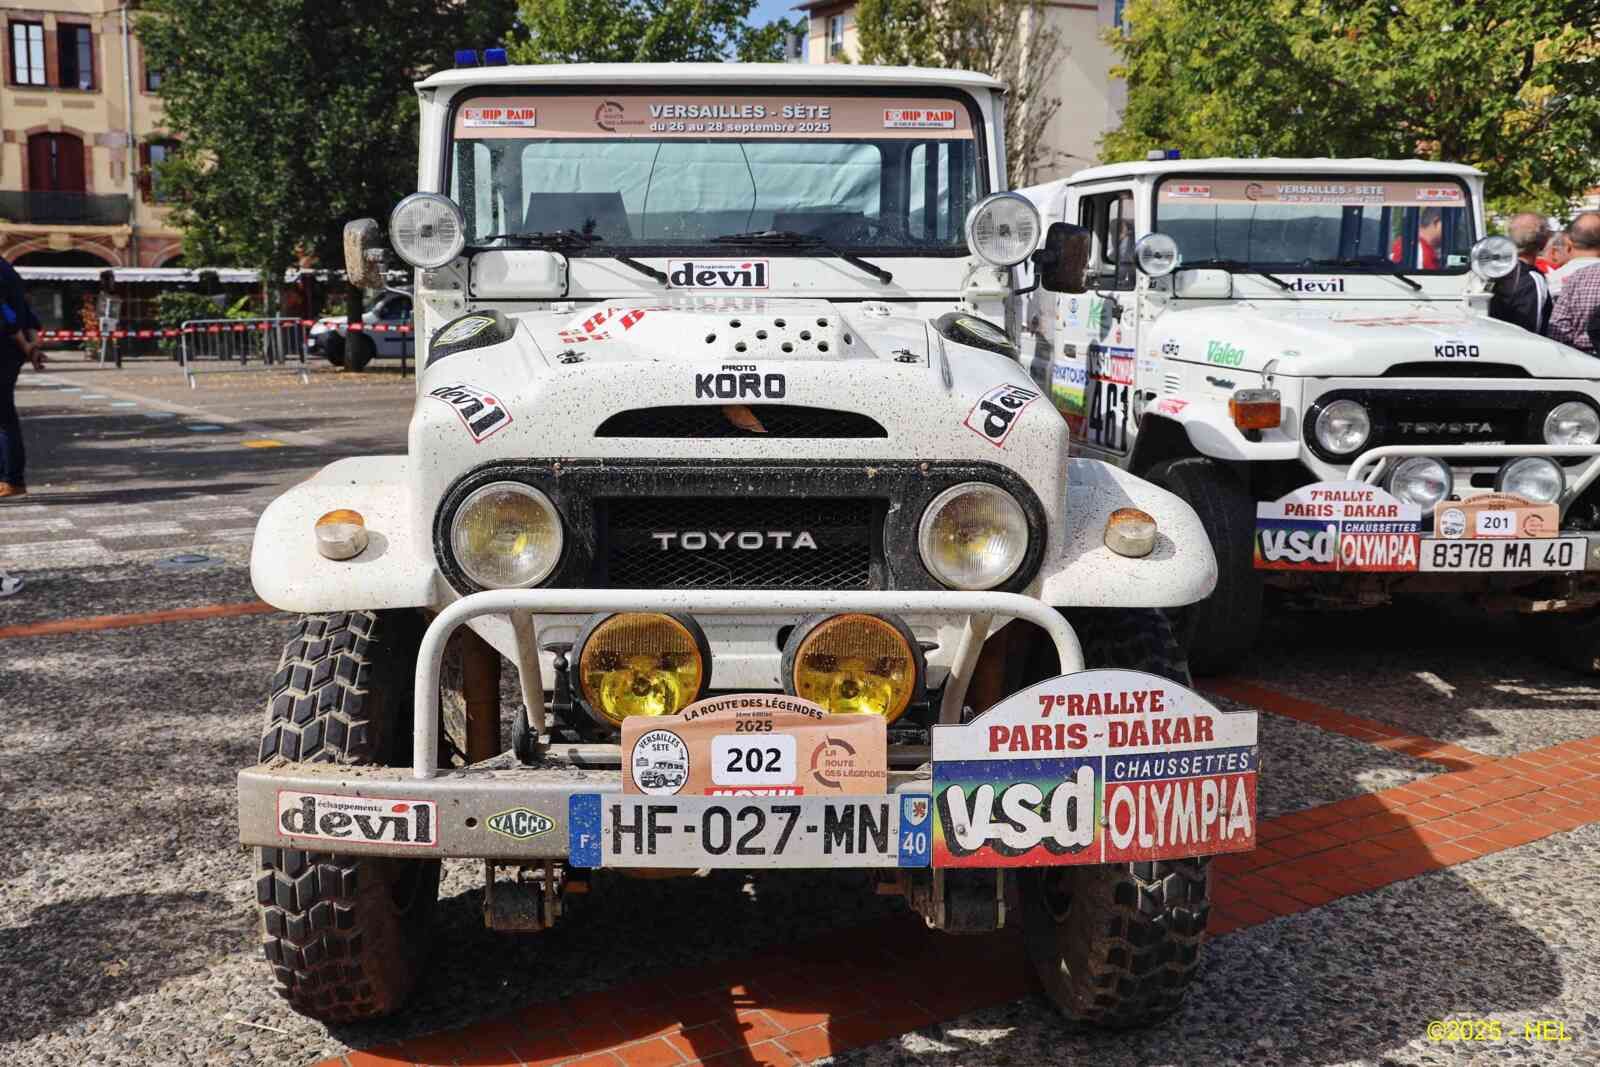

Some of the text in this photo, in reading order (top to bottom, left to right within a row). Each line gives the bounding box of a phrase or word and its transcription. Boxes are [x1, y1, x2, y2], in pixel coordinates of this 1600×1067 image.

[650, 104, 766, 119] VERSAILLES
[650, 122, 831, 133] du 26 au 28 septembre 2025
[1279, 184, 1345, 194] VERSAILLES
[670, 262, 766, 287] devil
[1289, 277, 1345, 293] devil
[1207, 340, 1246, 366] Valeo
[1434, 345, 1480, 358] KORO
[695, 373, 786, 399] KORO
[979, 384, 1040, 438] devil
[1398, 422, 1493, 434] TOYOTA
[1284, 503, 1334, 517] PARIS
[1343, 504, 1398, 517] DAKAR
[1484, 516, 1509, 529] 201
[652, 531, 818, 550] TOYOTA
[1345, 523, 1417, 533] CHAUSSETTES
[1261, 524, 1337, 563] vsd
[1341, 534, 1418, 567] OLYMPIA
[1432, 542, 1574, 568] 8378 MA 40
[684, 697, 824, 722] LA ROUTE DES LÉGENDES
[735, 720, 774, 732] 2025
[988, 721, 1088, 753] PARIS
[1108, 716, 1215, 748] DAKAR
[638, 733, 681, 749] VERSAILLES
[825, 749, 837, 757] LA
[726, 747, 782, 773] 202
[1114, 753, 1250, 779] CHAUSSETTES
[280, 795, 433, 843] devil
[318, 801, 383, 813] échappements
[944, 765, 1095, 853] vsd
[1108, 776, 1253, 851] OLYMPIA
[493, 808, 548, 836] YACCO
[612, 803, 890, 856] HF-027-MN
[580, 834, 592, 849] F
[902, 831, 927, 856] 40
